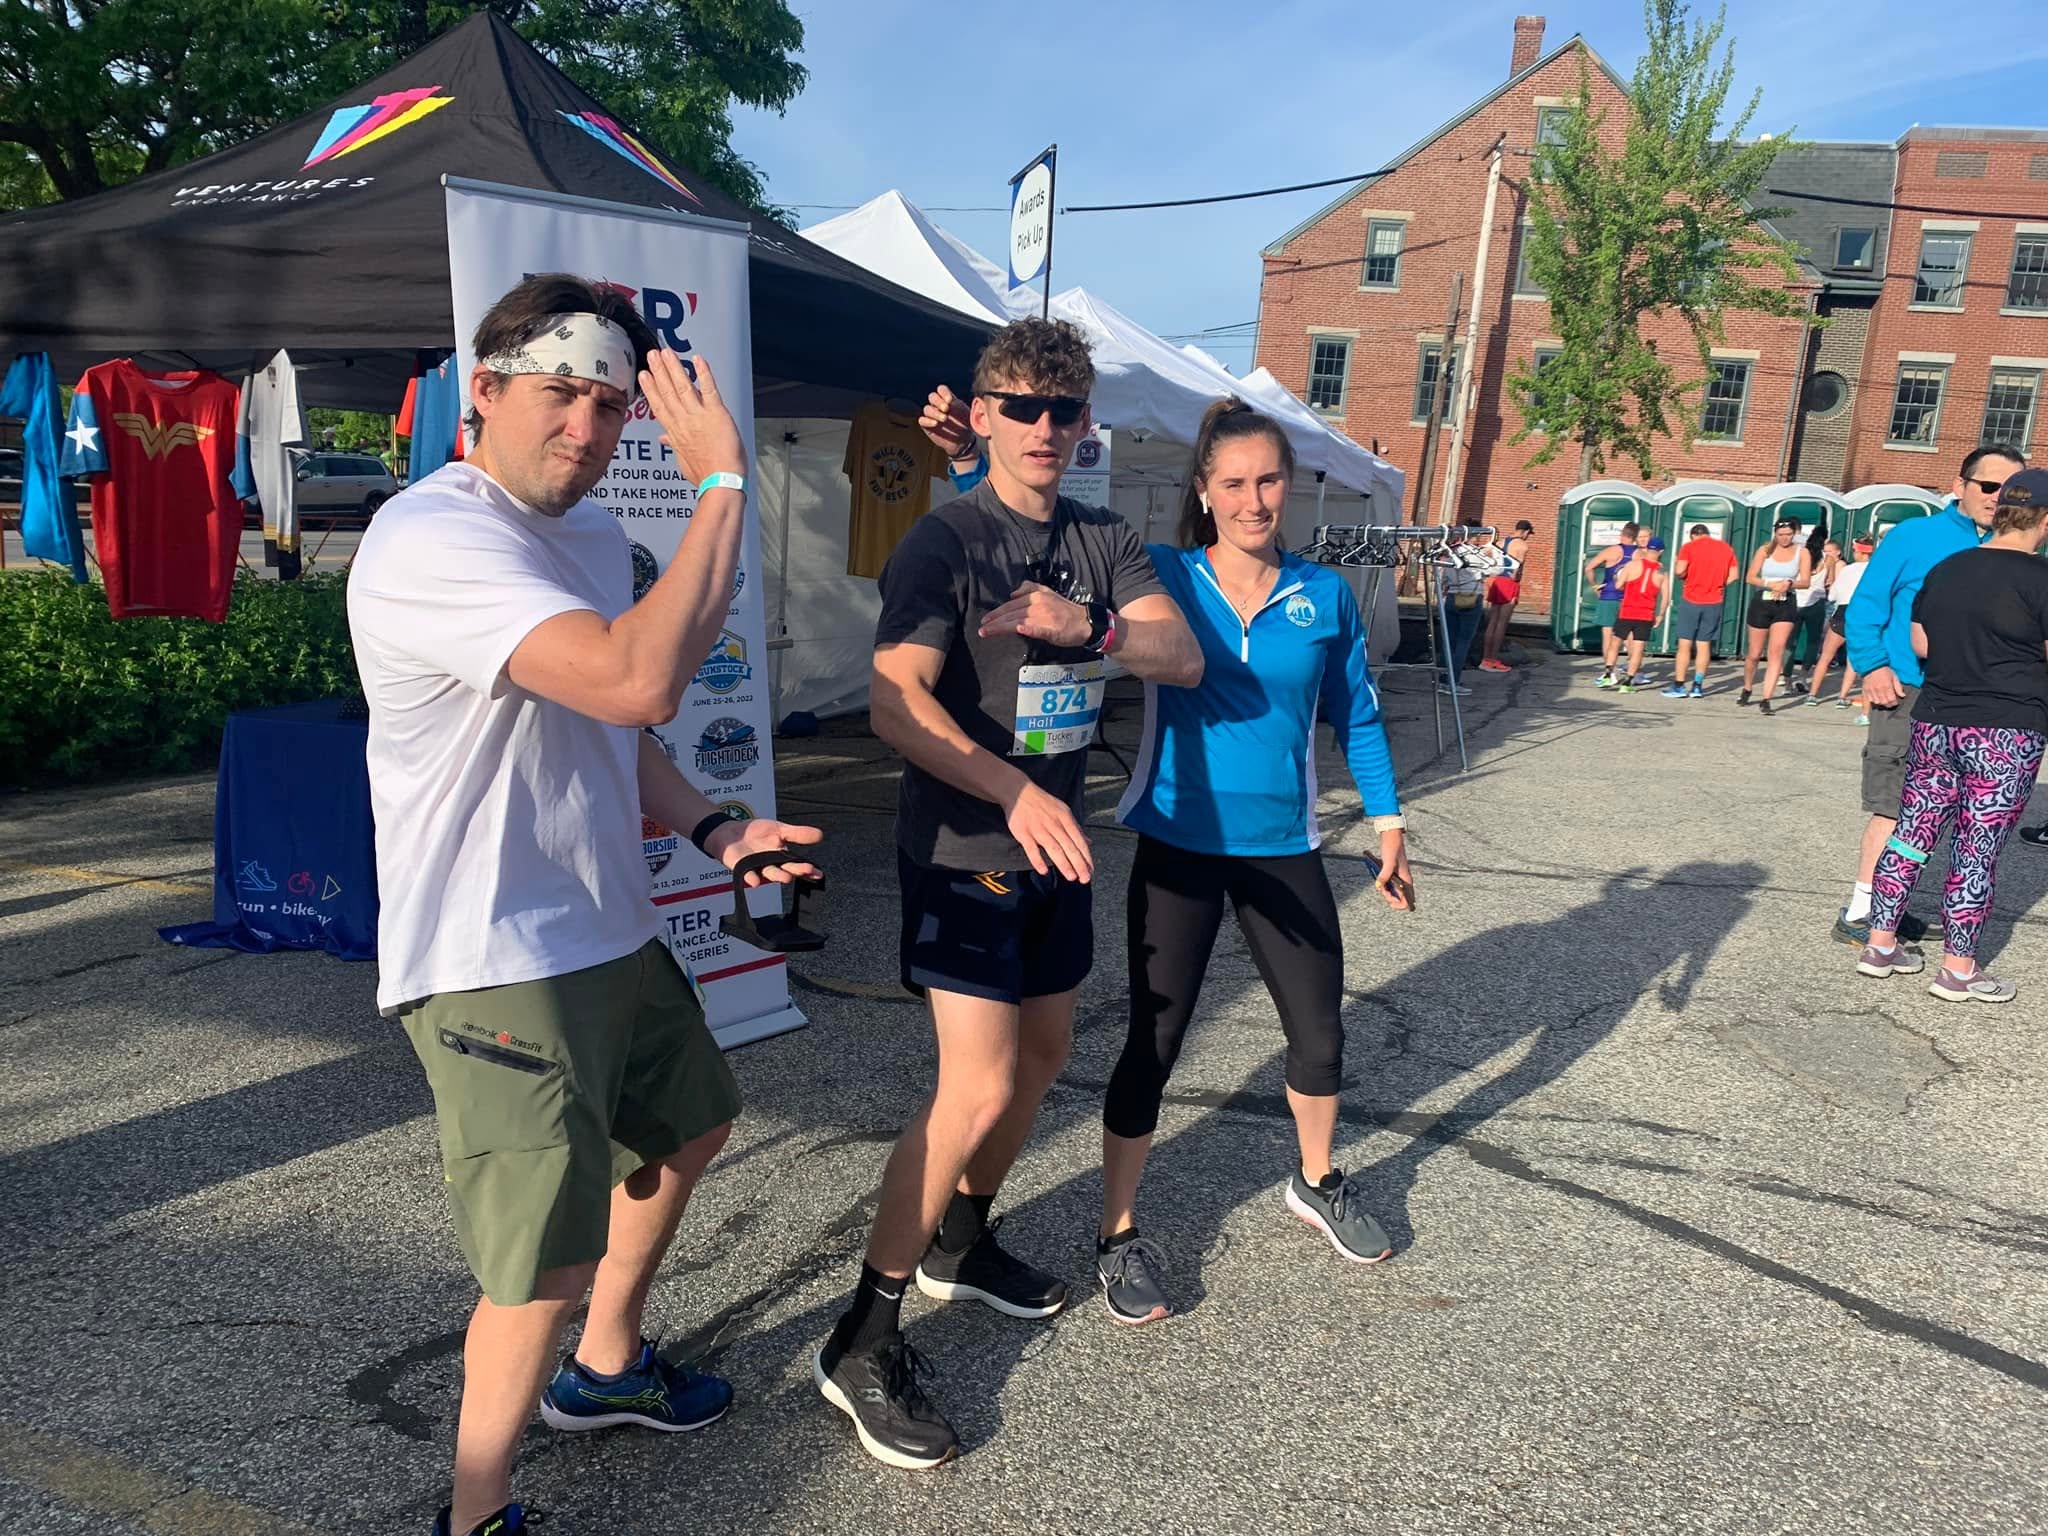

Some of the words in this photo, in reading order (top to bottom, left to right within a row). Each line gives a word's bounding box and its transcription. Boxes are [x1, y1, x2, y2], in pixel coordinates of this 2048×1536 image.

[175, 177, 375, 197] VENTURES
[171, 193, 321, 206] ENDURANCE
[1019, 188, 1045, 219] Awards
[1017, 229, 1031, 254] Pick
[1033, 224, 1044, 247] Up
[613, 469, 649, 479] FOUR
[652, 470, 687, 480] QUAL
[612, 488, 647, 499] TAKE
[651, 489, 687, 500] HOME
[628, 507, 663, 518] RACE
[666, 508, 693, 518] MED
[1041, 686, 1087, 714] 874
[1028, 717, 1054, 728] Half
[1047, 731, 1073, 741] Tucker
[695, 749, 731, 768] FLIGHT
[732, 745, 760, 763] DECK
[704, 788, 721, 796] SEPT
[735, 784, 753, 792] 2022
[672, 877, 689, 887] 2022
[282, 902, 315, 916] bike
[667, 909, 711, 935] TER
[685, 944, 729, 962] -SERIES
